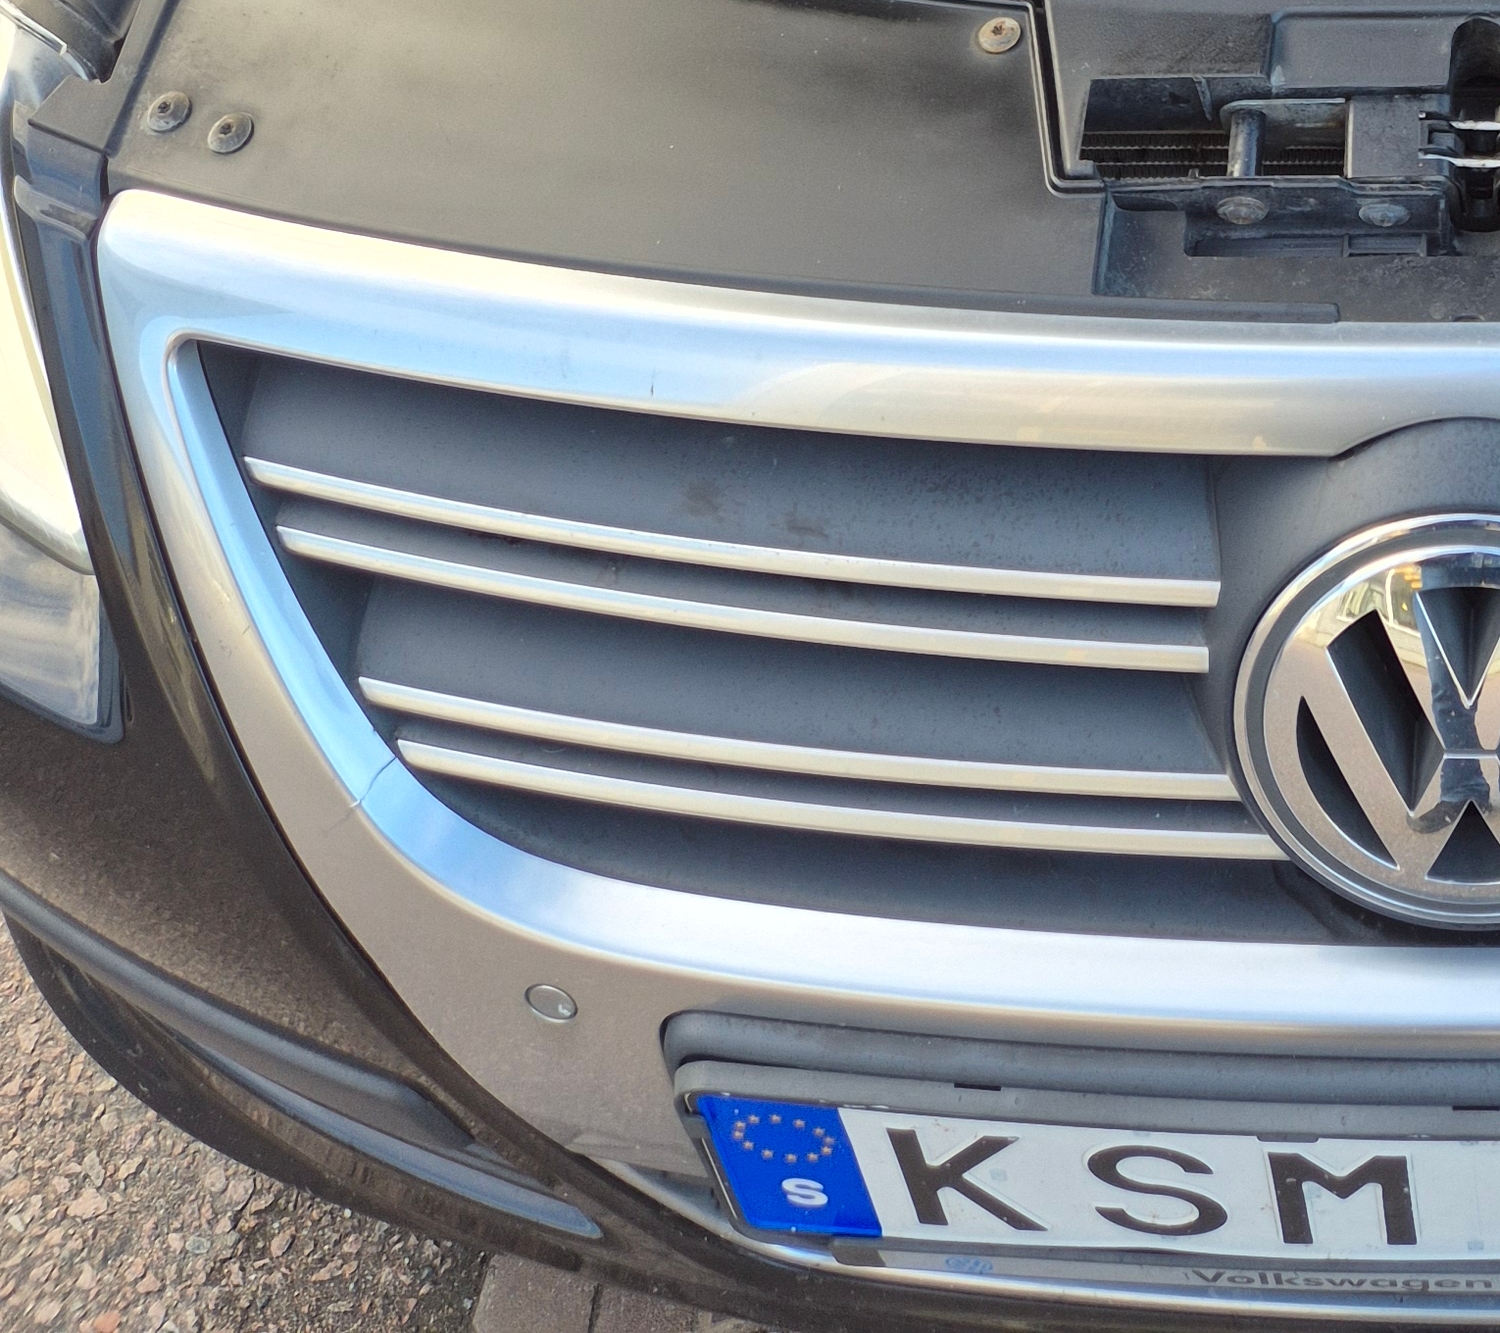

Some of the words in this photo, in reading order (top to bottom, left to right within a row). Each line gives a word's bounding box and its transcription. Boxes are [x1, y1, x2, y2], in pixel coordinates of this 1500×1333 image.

[782, 1177, 828, 1208] S
[885, 1127, 1418, 1246] KSM
[1192, 1269, 1494, 1293] Volkswagen
